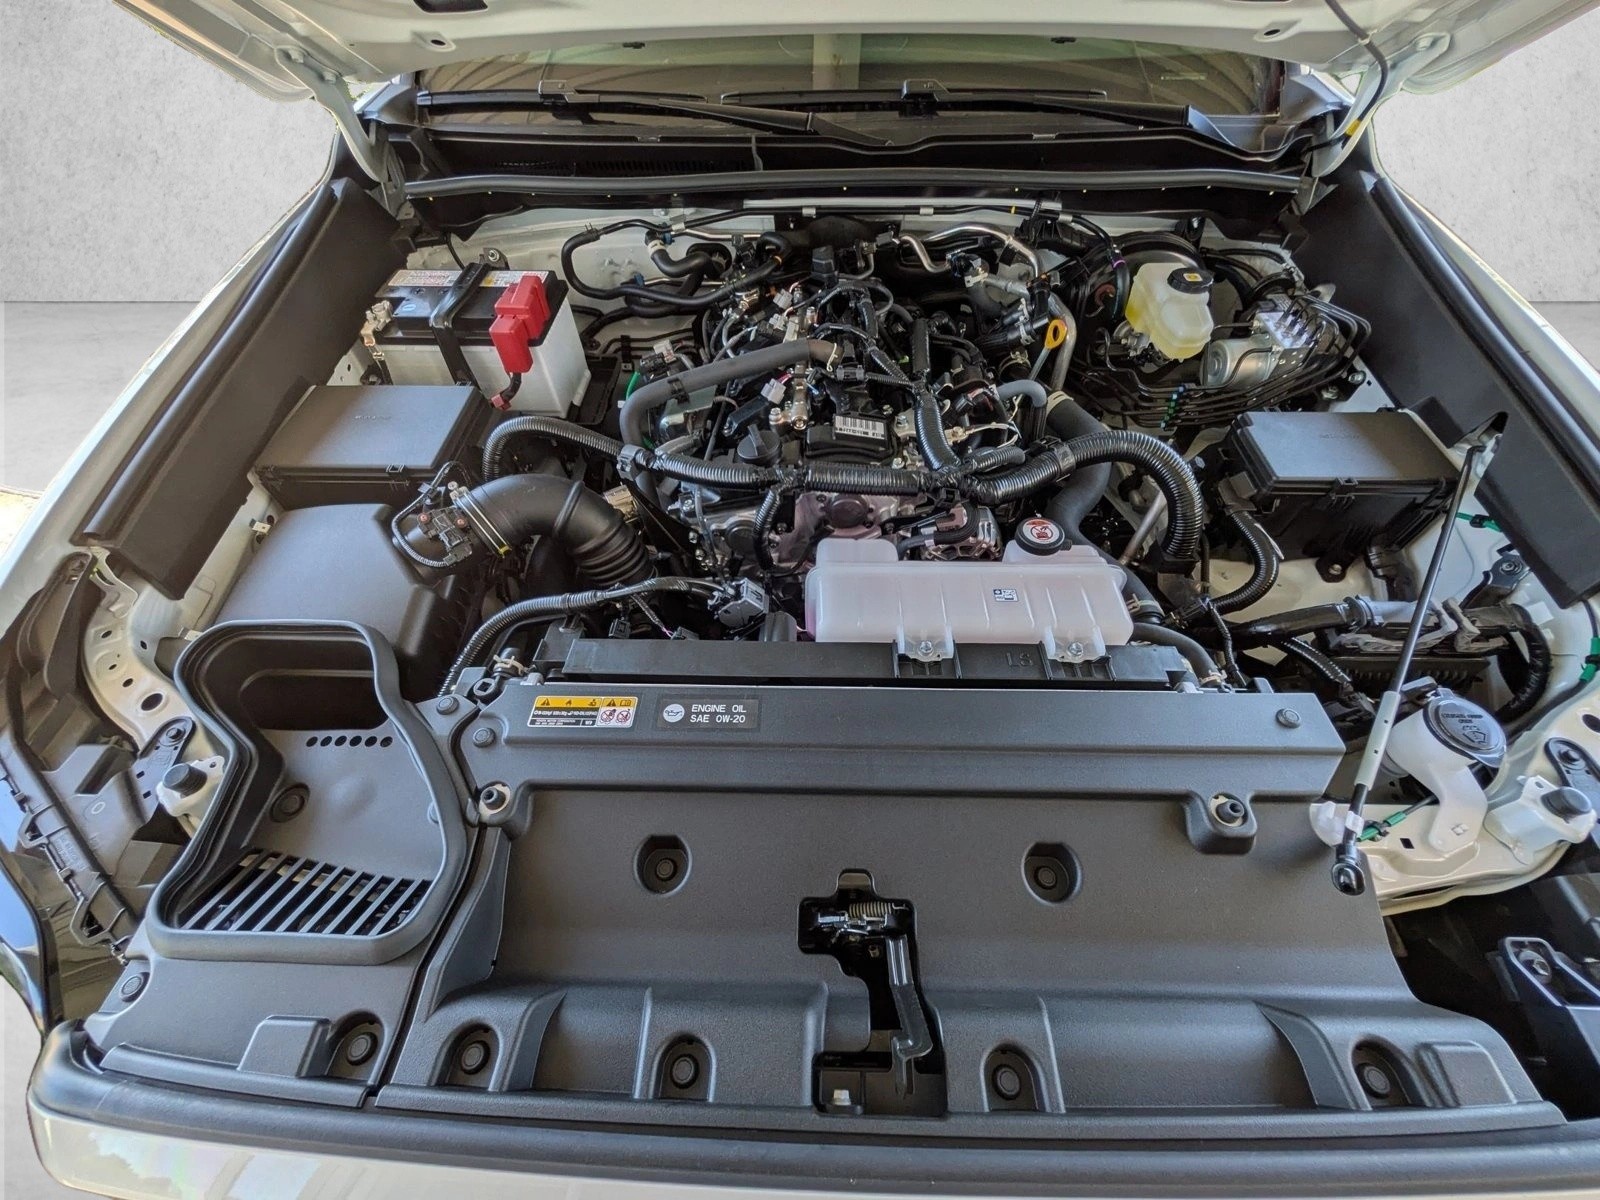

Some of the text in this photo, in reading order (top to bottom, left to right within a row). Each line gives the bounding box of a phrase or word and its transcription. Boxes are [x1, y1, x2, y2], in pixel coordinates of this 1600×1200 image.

[691, 704, 746, 713] ENGINE OIL
[689, 714, 746, 723] SAE 0W-20
